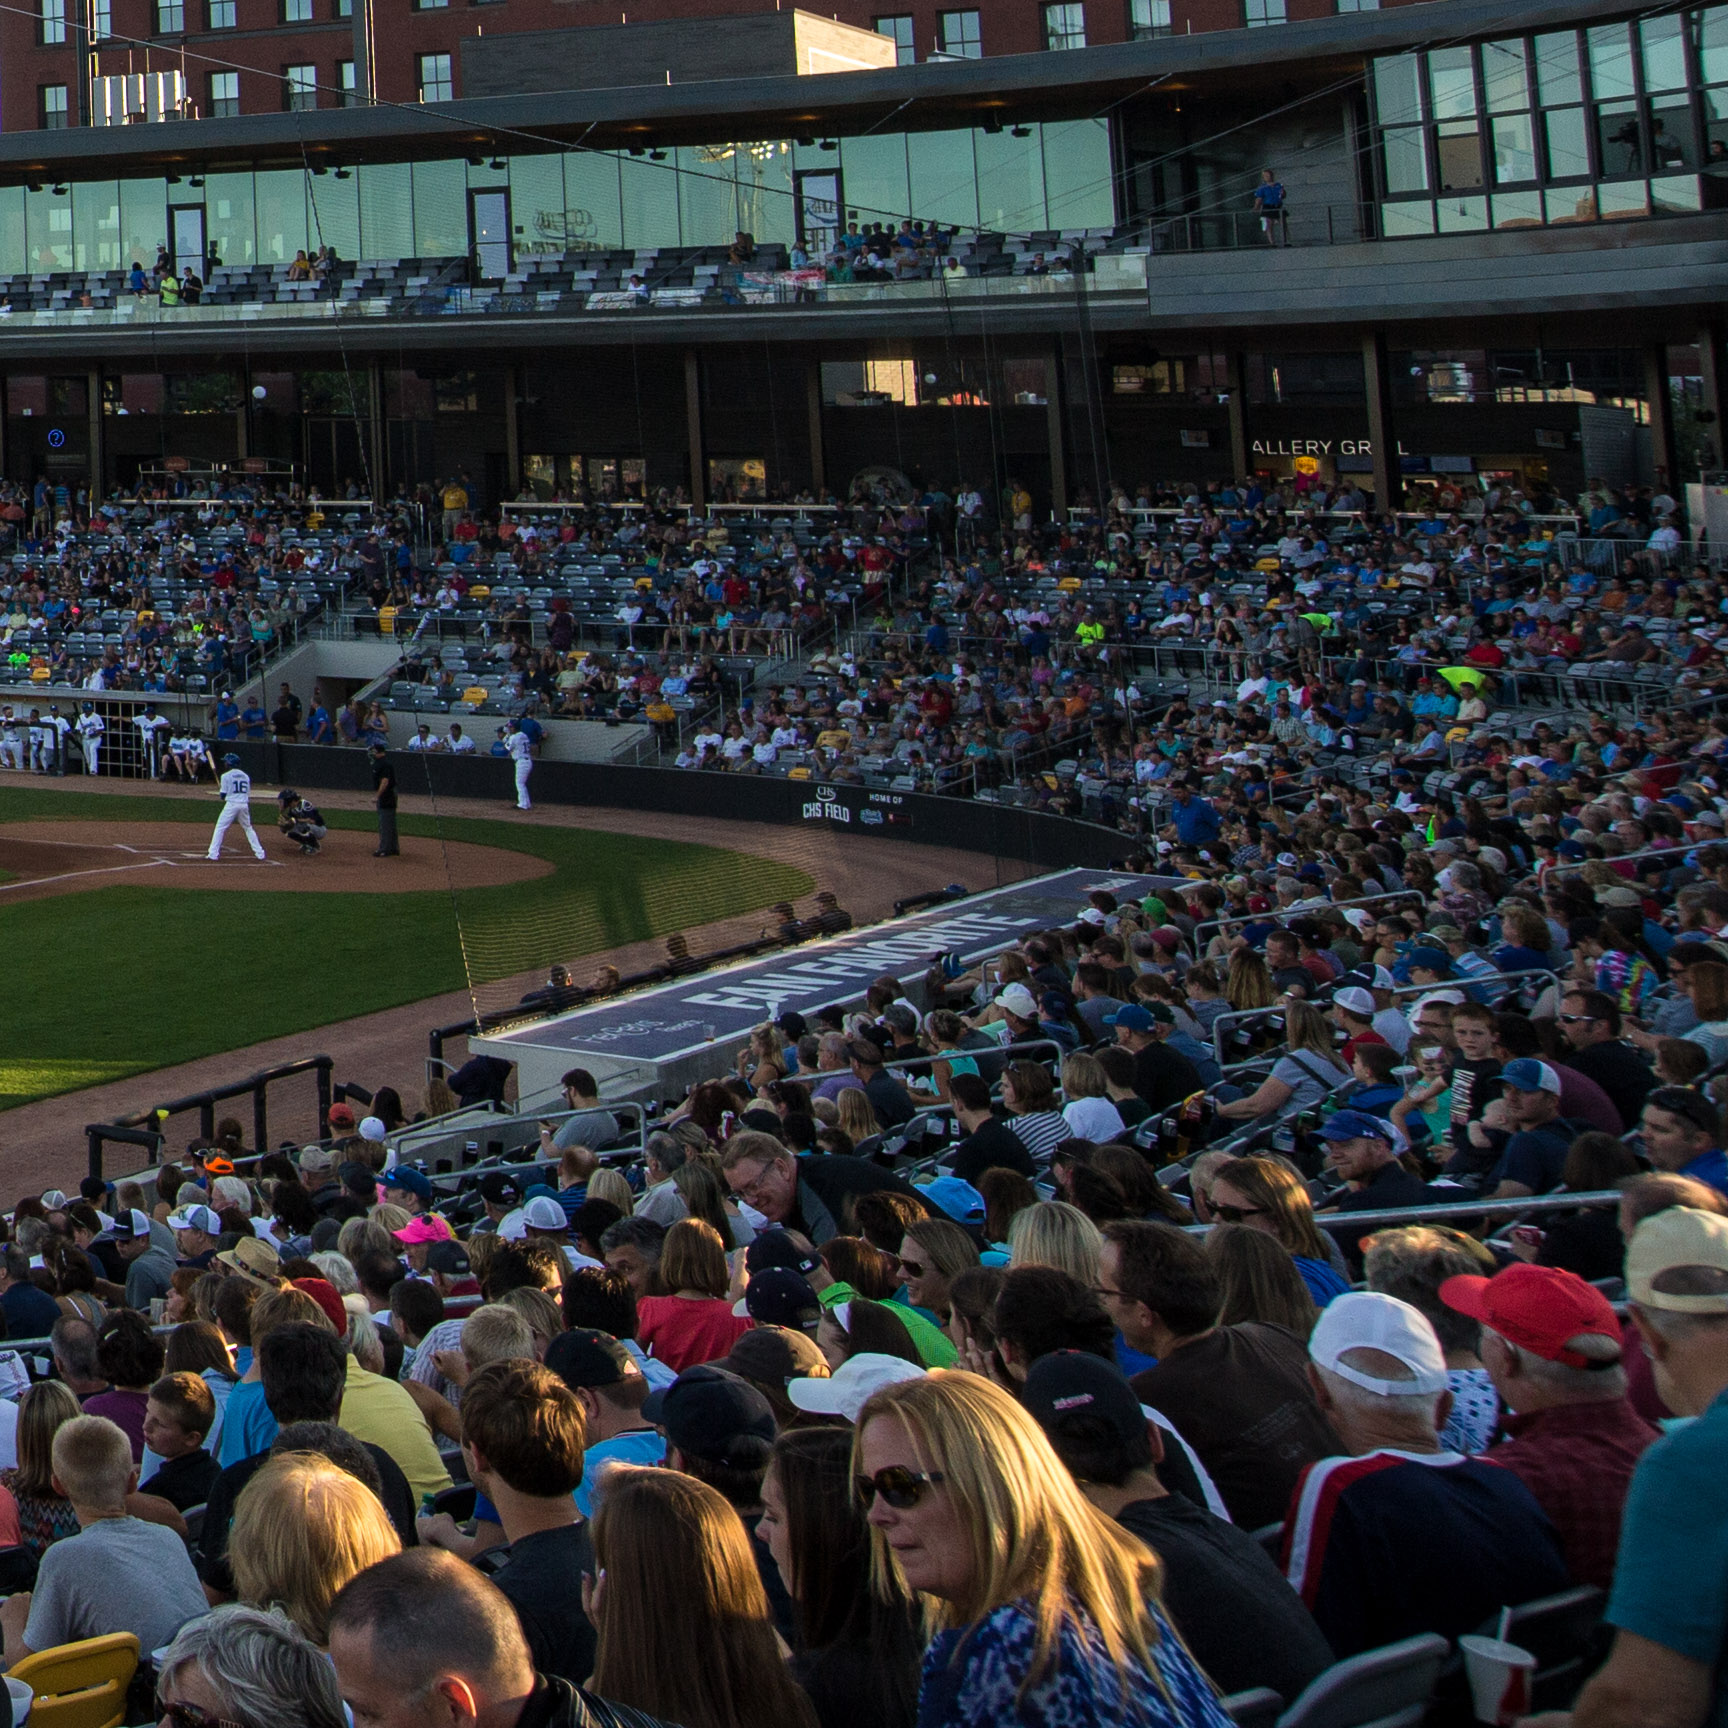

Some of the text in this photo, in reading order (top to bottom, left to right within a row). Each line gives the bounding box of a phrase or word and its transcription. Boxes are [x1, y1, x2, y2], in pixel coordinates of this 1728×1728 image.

[1252, 440, 1410, 456] ALLERY GRL
[233, 780, 248, 794] 16
[803, 802, 822, 819] CHS
[825, 802, 850, 823] FIELD
[680, 913, 1041, 1011] FAN FAVORITE
